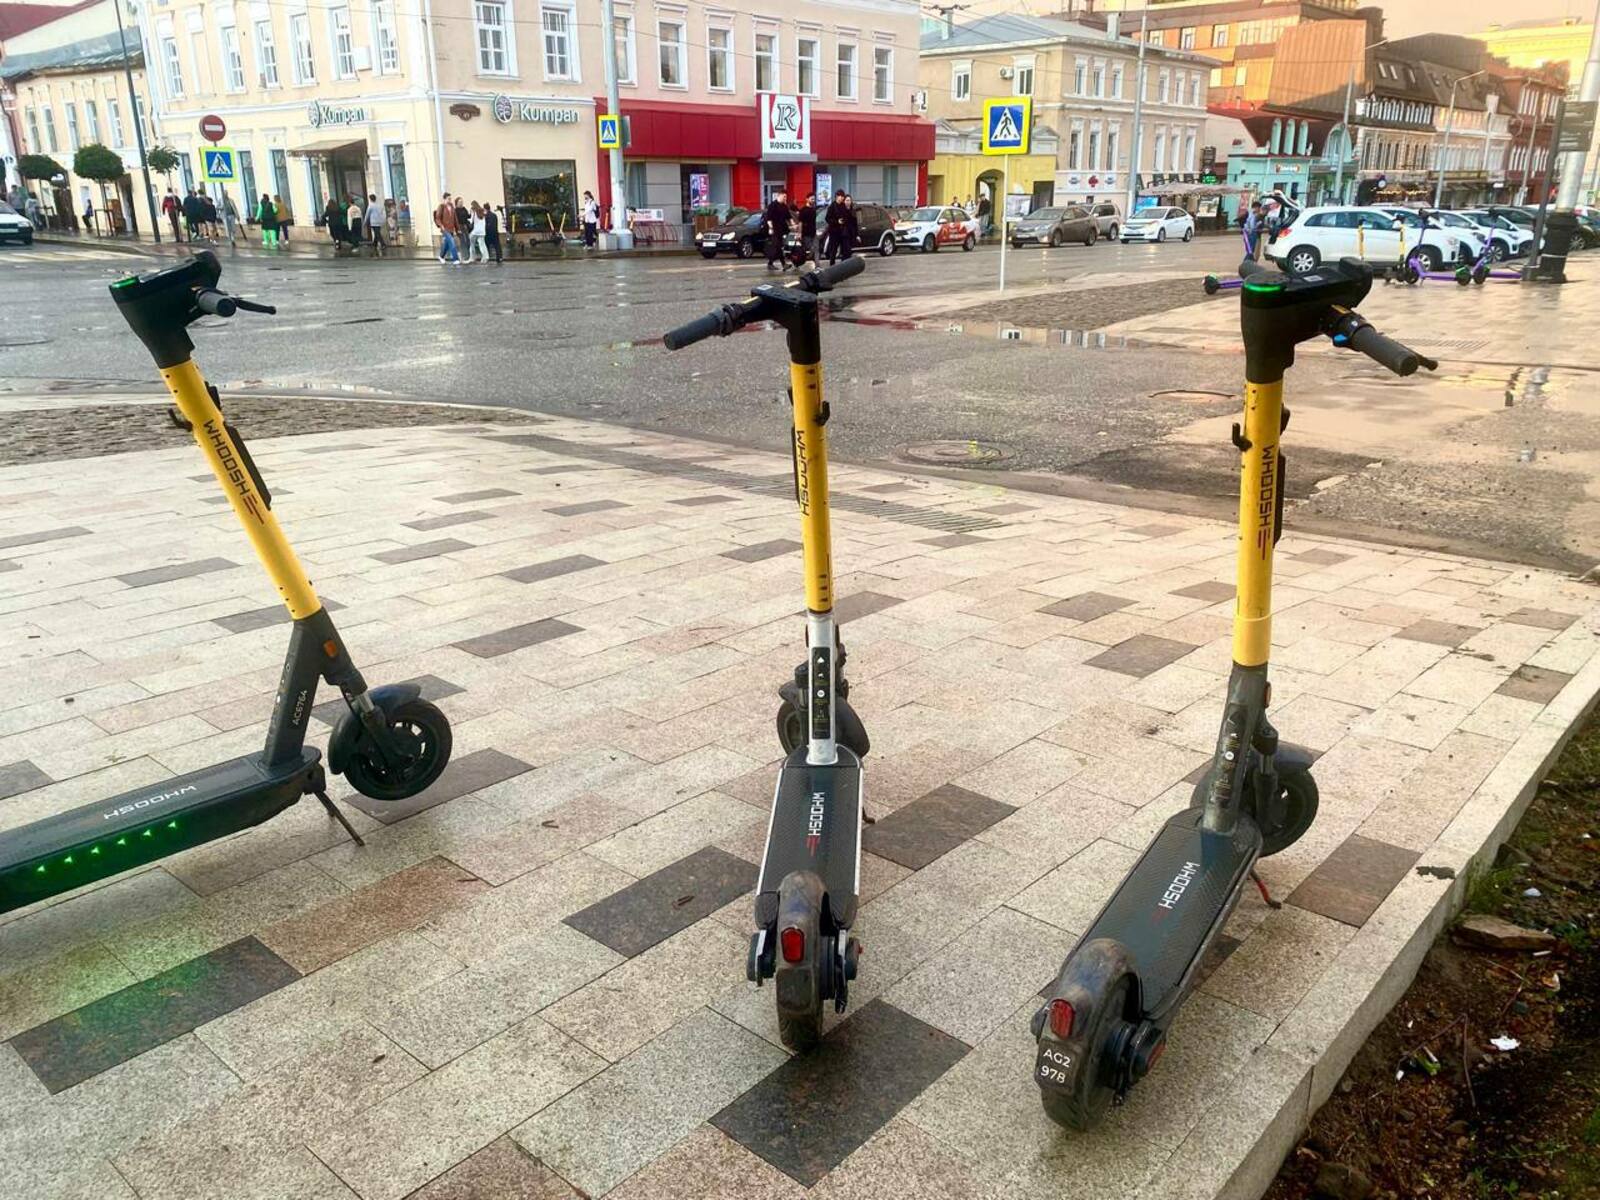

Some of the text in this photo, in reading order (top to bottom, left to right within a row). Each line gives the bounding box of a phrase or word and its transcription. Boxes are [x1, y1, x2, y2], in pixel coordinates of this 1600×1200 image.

[519, 102, 580, 126] Kumpan
[203, 419, 251, 496] WHOOSH
[1259, 444, 1275, 527] WHOOSH
[103, 785, 197, 819] WHOOSH
[807, 791, 825, 836] WHOOSH
[1158, 861, 1201, 910] WHOOSH
[1040, 1065, 1066, 1084] 978
[1043, 1048, 1071, 1068] AG2
